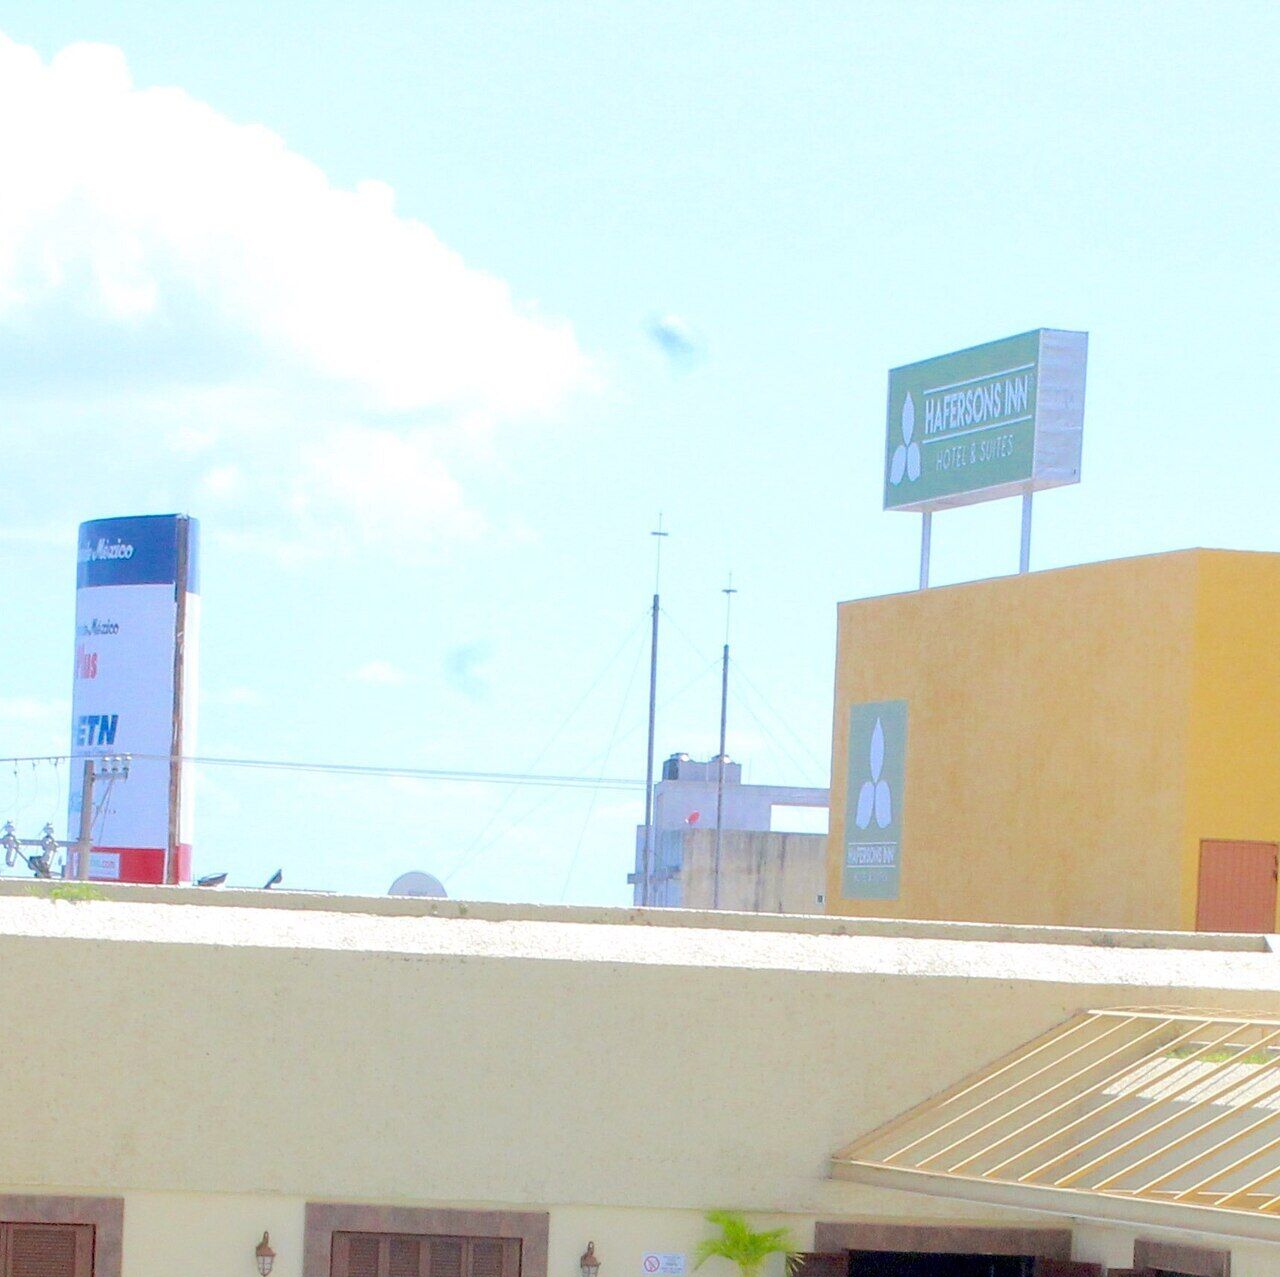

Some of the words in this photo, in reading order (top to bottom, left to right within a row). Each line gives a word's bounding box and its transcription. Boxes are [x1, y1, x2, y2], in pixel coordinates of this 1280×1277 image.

[925, 382, 1001, 434] HAFERSONS
[1004, 375, 1028, 416] INN
[936, 445, 966, 471] HOTEL
[980, 434, 1014, 461] SUITES
[77, 714, 118, 746] ETN
